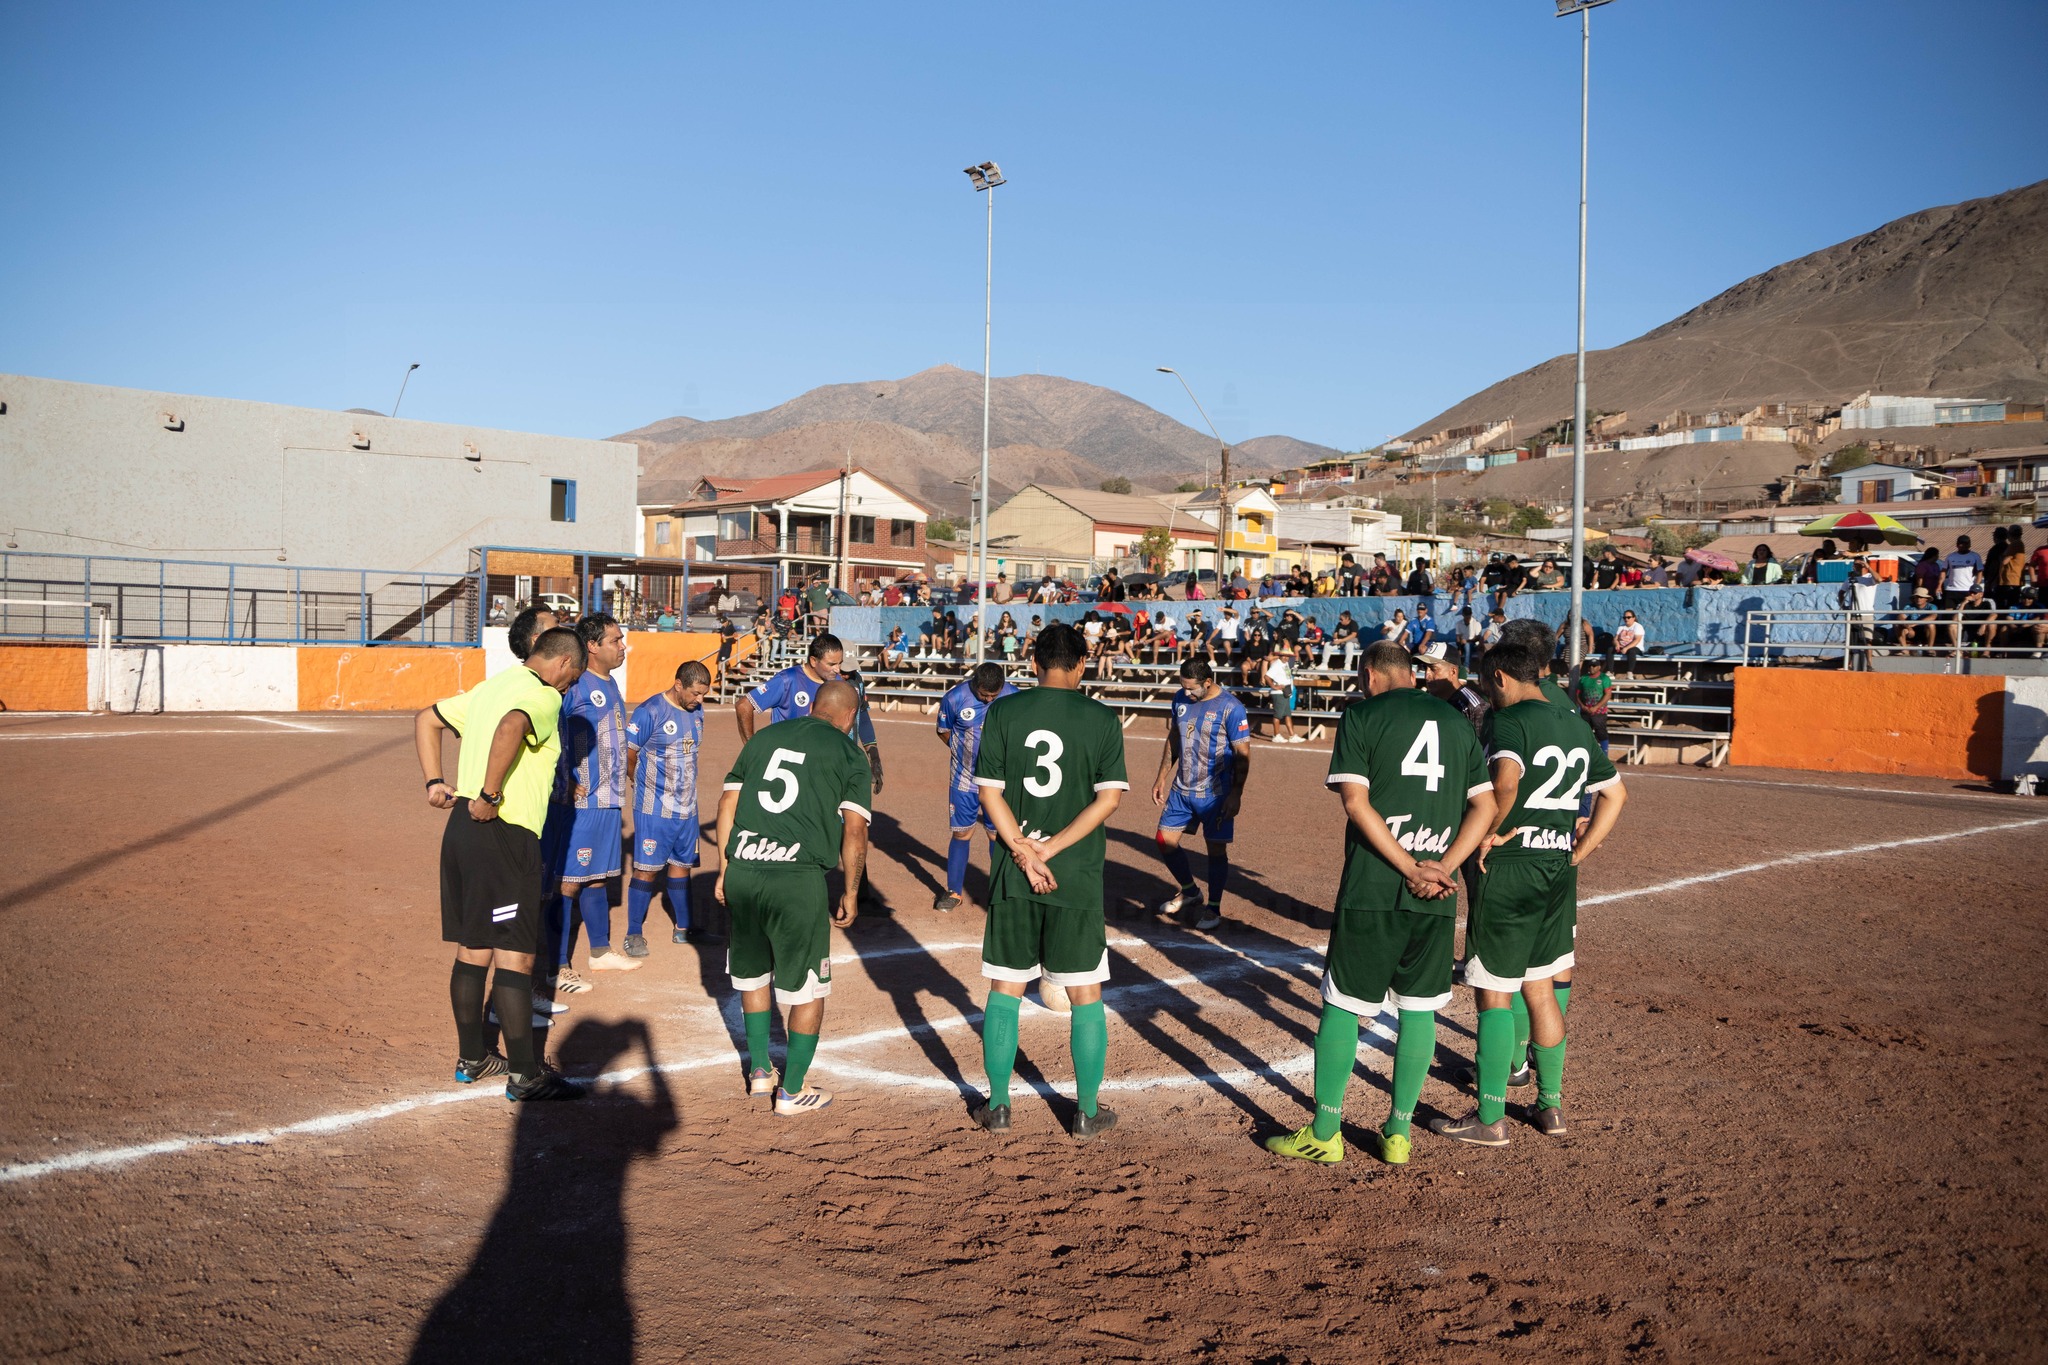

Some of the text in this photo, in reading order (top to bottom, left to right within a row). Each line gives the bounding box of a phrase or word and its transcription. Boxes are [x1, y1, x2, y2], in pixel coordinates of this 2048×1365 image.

[682, 739, 695, 754] 17
[1186, 724, 1195, 739] 7
[1023, 729, 1064, 798] 3
[1401, 720, 1445, 792] 4
[757, 747, 807, 814] 5
[1523, 745, 1591, 811] 22
[734, 830, 801, 861] Taltal
[1385, 814, 1451, 854] Taltal
[1321, 1104, 1342, 1113] mitr
[1484, 1093, 1505, 1102] mitr
